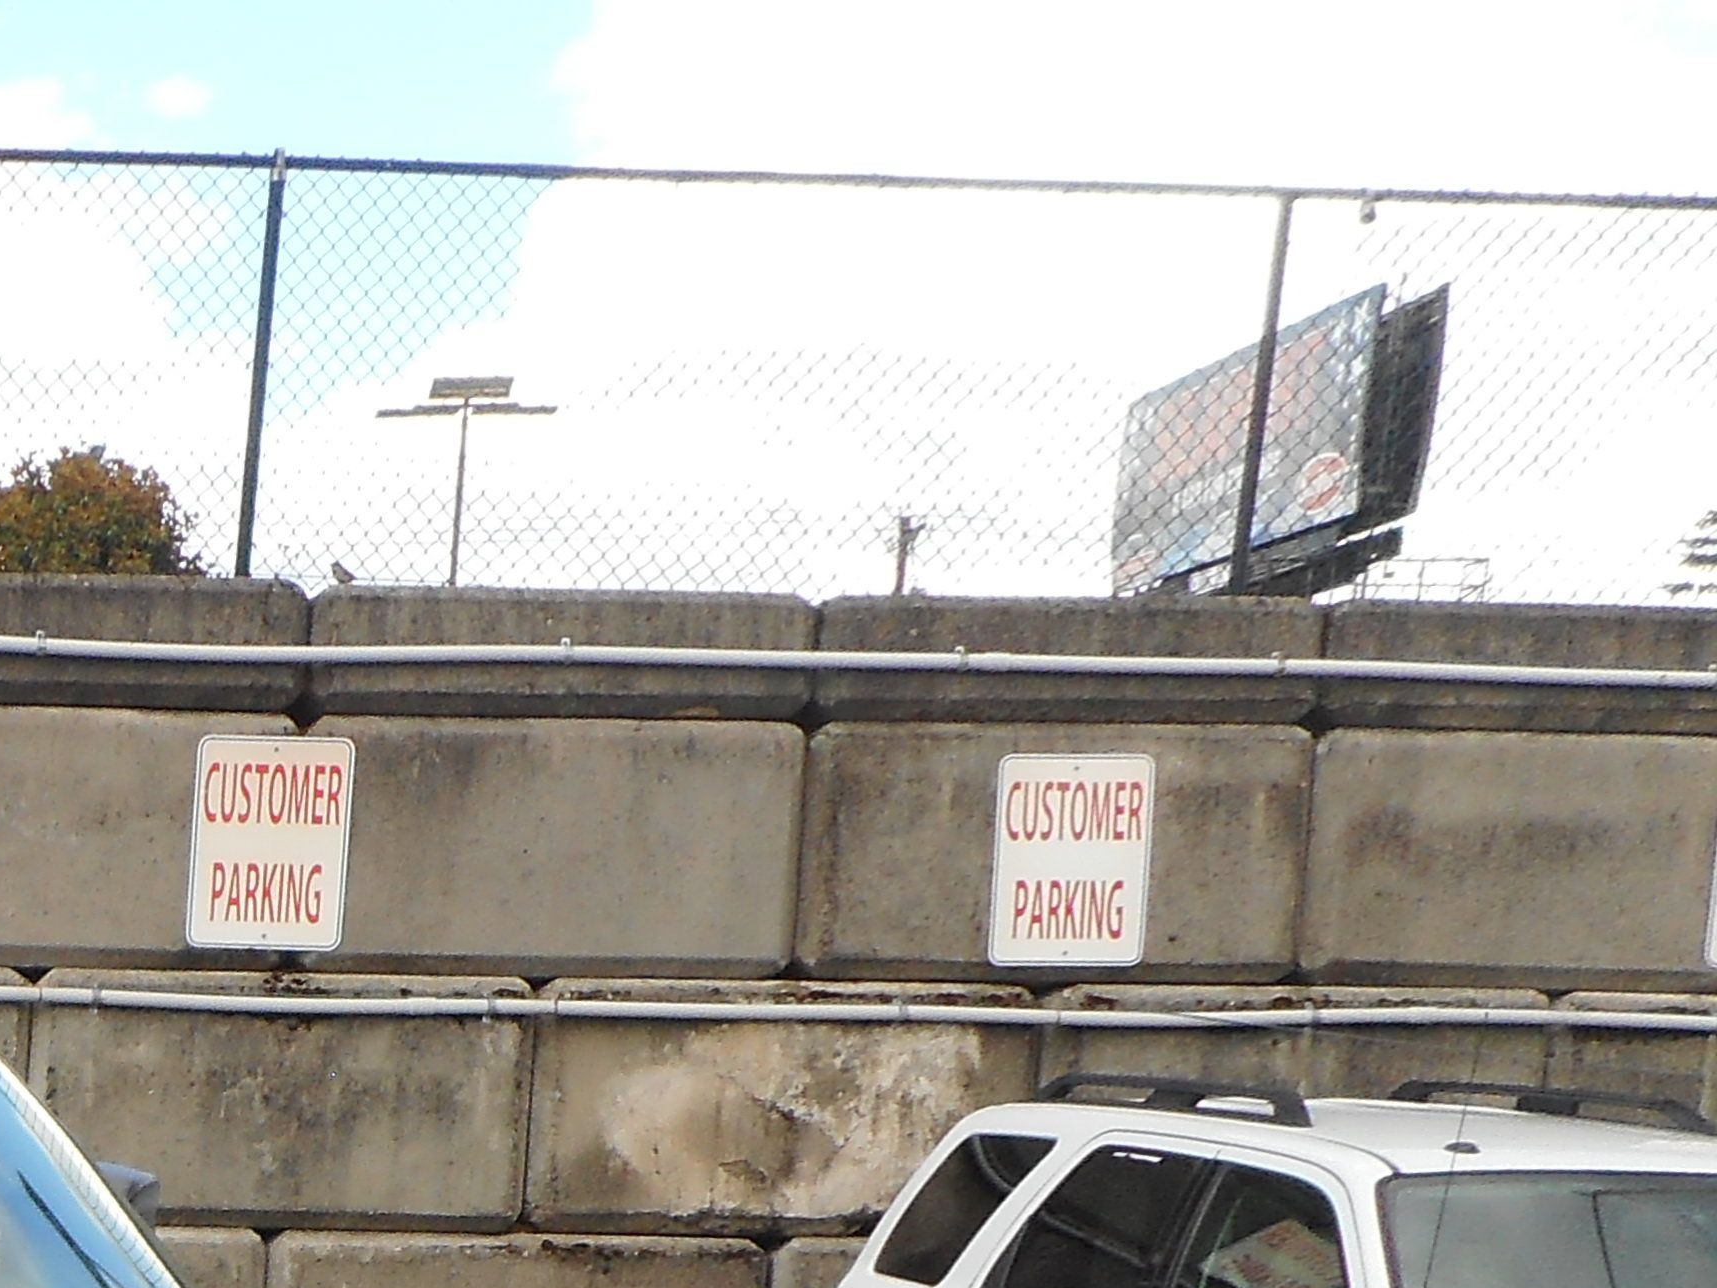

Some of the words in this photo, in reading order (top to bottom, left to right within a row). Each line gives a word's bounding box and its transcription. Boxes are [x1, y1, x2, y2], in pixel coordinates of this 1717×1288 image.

[203, 762, 343, 825] CUSTOMER
[1005, 781, 1143, 841] CUSTOMER
[209, 862, 322, 924] PARKING
[1012, 880, 1124, 939] PARKING
